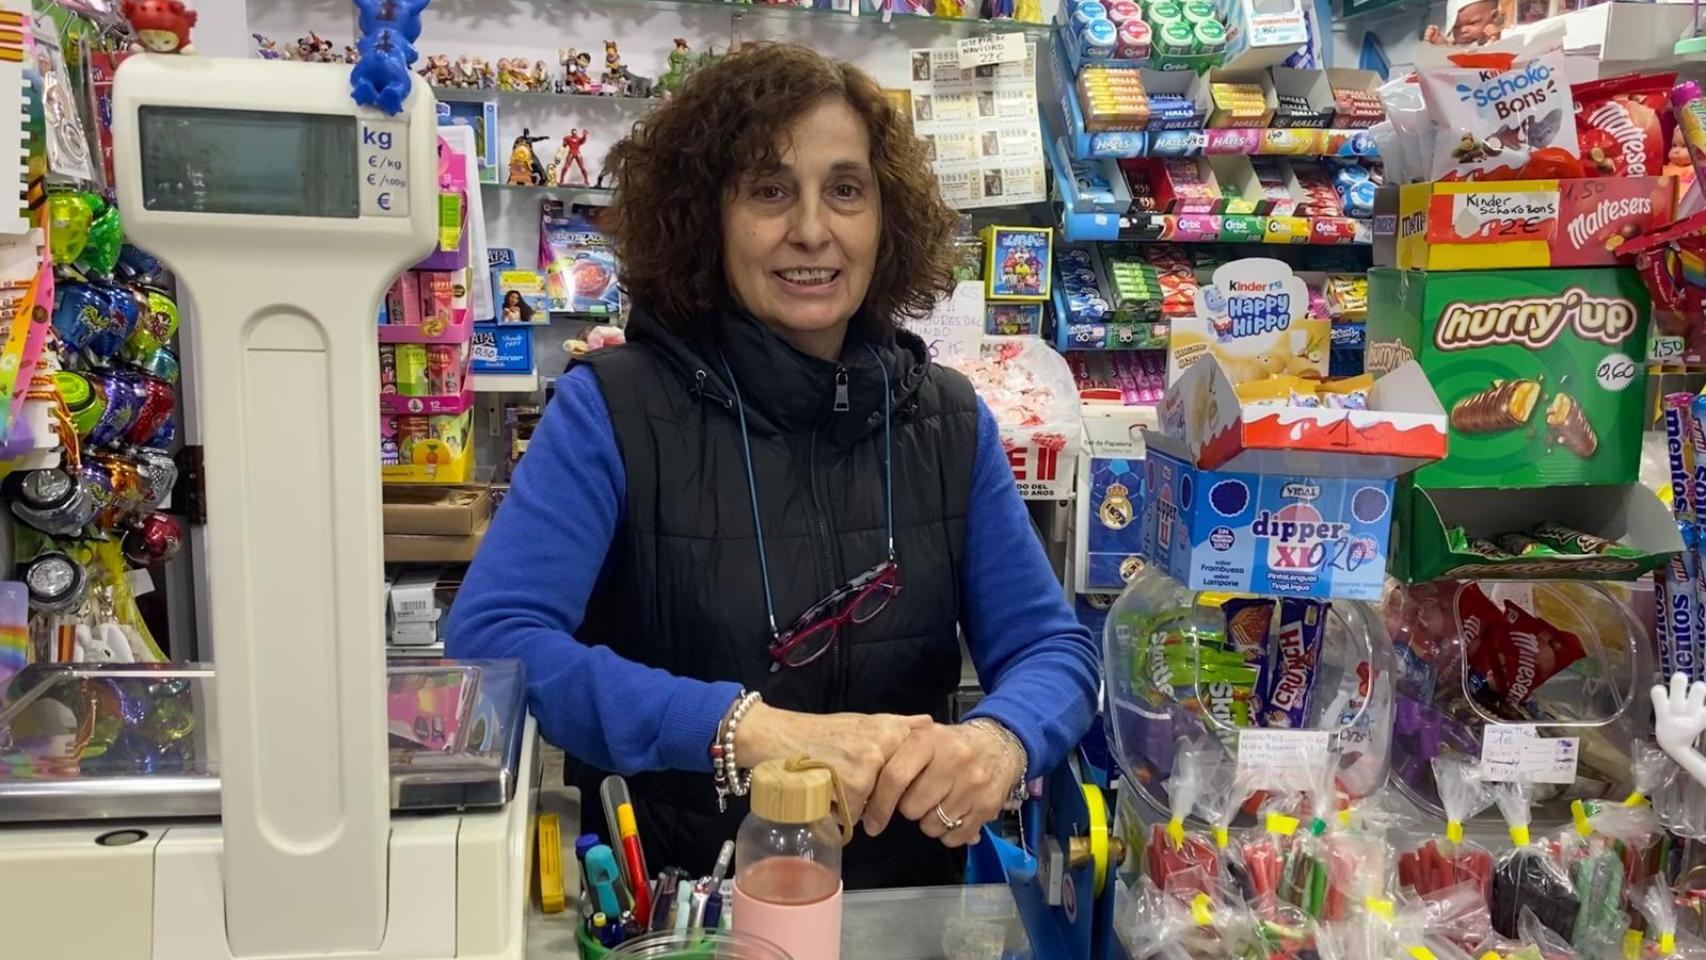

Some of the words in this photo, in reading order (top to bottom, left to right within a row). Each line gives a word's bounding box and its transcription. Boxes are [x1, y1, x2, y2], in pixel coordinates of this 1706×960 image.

[1494, 88, 1546, 120] Bons
[363, 126, 392, 150] kg
[1212, 137, 1245, 147] HALLS
[1588, 100, 1648, 178] Maltese
[377, 192, 391, 210] €
[1466, 194, 1511, 206] Kinder
[1225, 219, 1248, 230] Orbit
[1315, 220, 1338, 232] Orbit
[1500, 216, 1540, 235] 2€
[1567, 197, 1651, 250] Maltesers
[1597, 363, 1636, 381] 0,60
[1666, 408, 1690, 512] mentos
[1286, 487, 1317, 497] VIDAL
[1251, 510, 1345, 543] dipper
[1308, 537, 1366, 572] 0,20
[1201, 564, 1245, 573] Frambuesa
[1203, 578, 1240, 587] Lampone
[1275, 627, 1302, 706] CRUNCH
